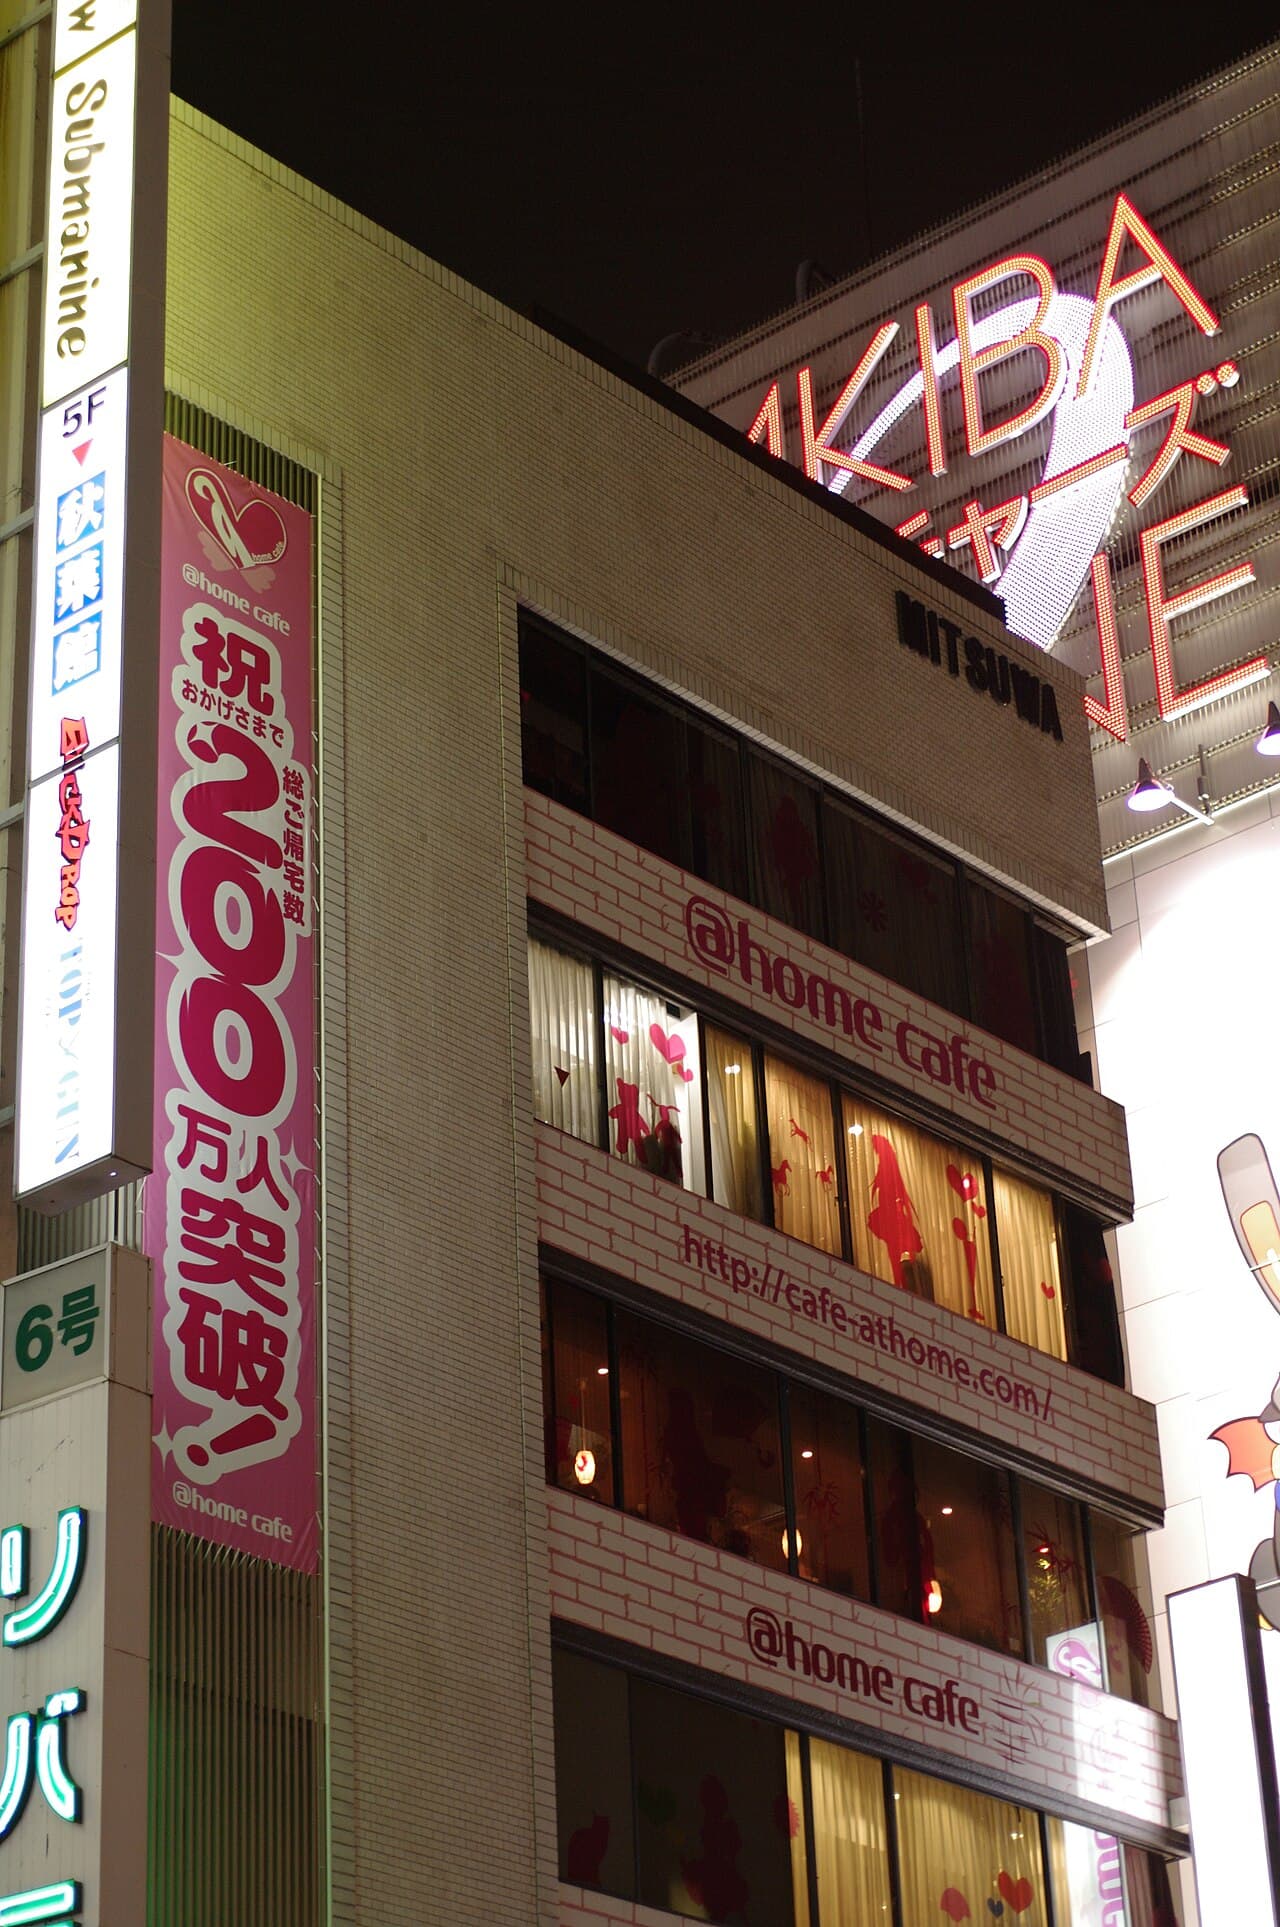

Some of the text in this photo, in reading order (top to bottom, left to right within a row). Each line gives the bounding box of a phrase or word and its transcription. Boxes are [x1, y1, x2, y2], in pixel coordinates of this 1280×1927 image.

[62, 386, 107, 440] 5F
[182, 563, 291, 636] @home cafe
[181, 679, 285, 748] おかげさまで
[192, 617, 274, 716] 祝
[895, 590, 1064, 743] MITSUWA
[282, 766, 305, 927] 総ご帰宅数
[686, 896, 997, 1111] @home cafe
[14, 1283, 100, 1374] 6号
[681, 1223, 1053, 1421] http://cafe-athome.com/
[173, 1481, 293, 1543] @home cafe
[746, 1607, 981, 1735] @home cafe
